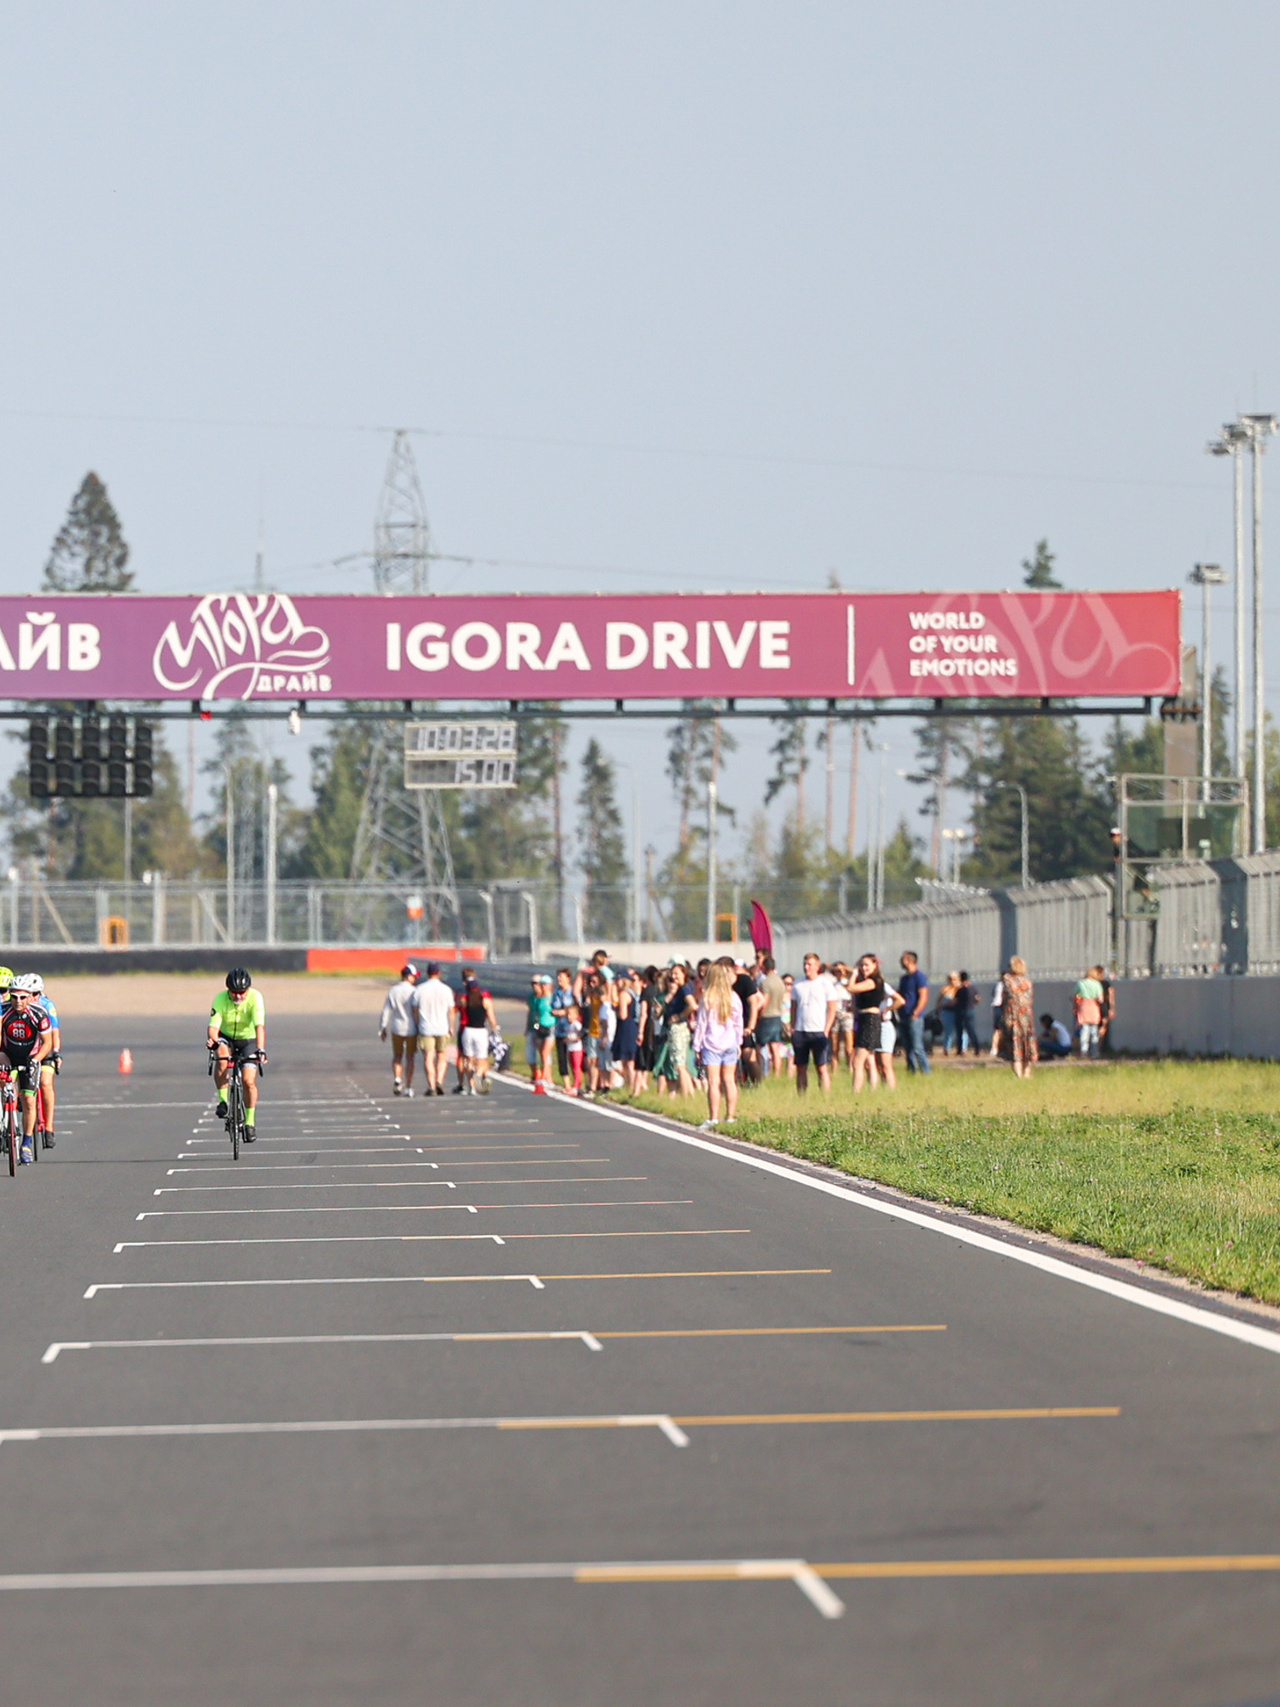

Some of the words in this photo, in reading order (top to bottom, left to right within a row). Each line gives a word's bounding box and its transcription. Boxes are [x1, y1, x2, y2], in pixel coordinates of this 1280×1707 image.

[909, 611, 986, 630] WORLD
[386, 621, 591, 672] IGORA
[605, 620, 791, 669] DRIVE
[909, 634, 938, 653] OF
[939, 634, 998, 653] YOUR
[909, 658, 1018, 676] EMOTIONS
[256, 671, 332, 692] ДРАЙВ
[417, 726, 516, 750] 10:03:28
[12, 1028, 26, 1039] 88
